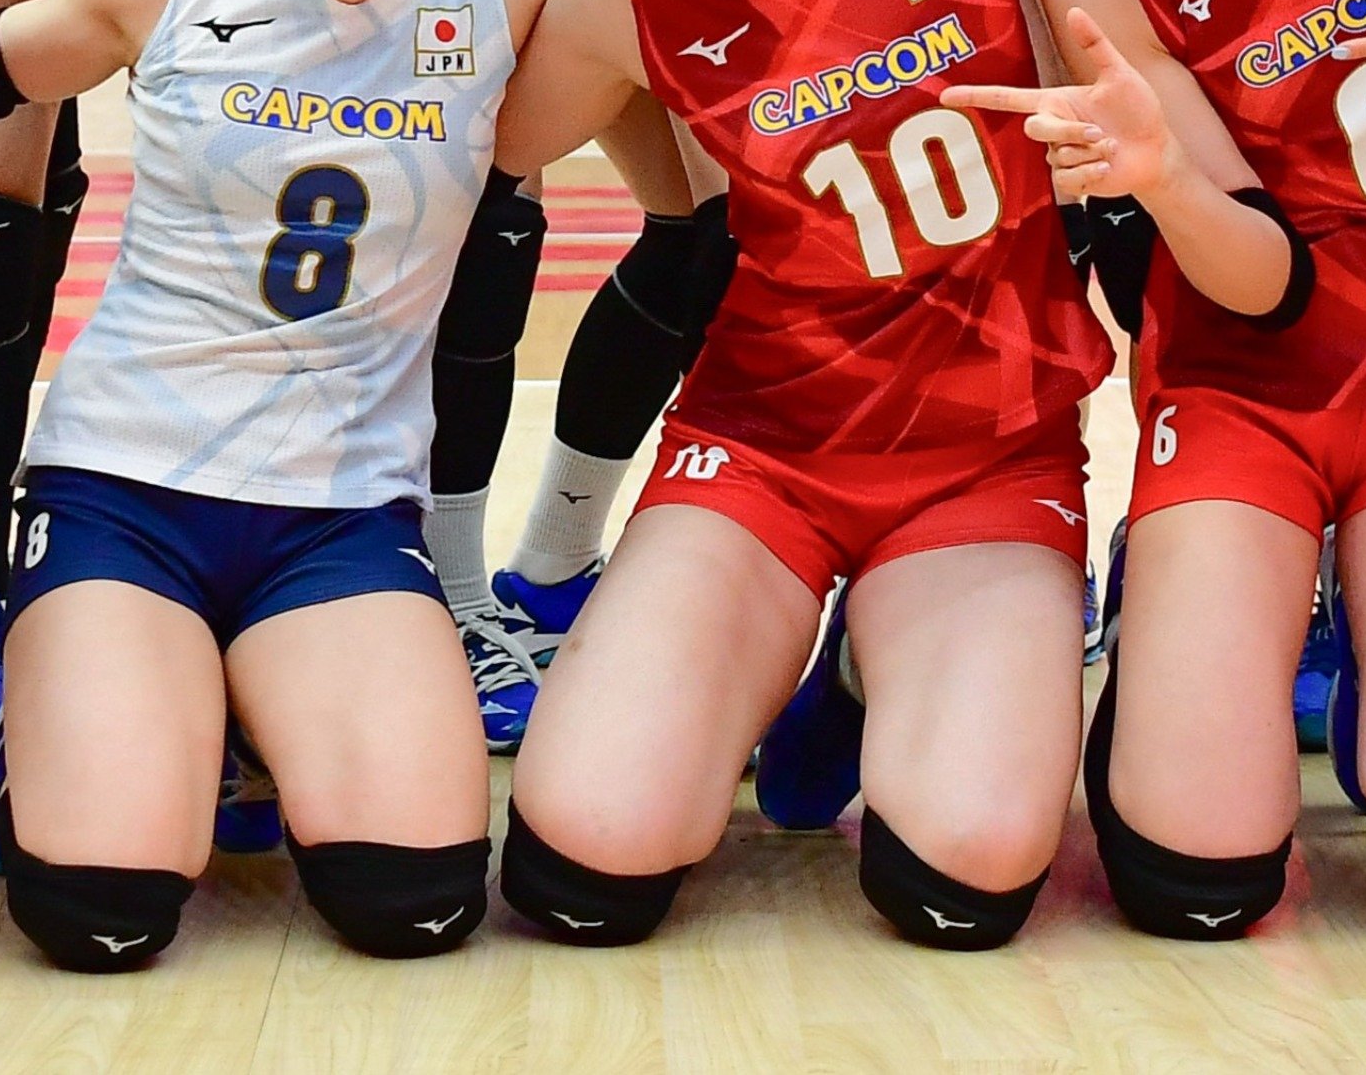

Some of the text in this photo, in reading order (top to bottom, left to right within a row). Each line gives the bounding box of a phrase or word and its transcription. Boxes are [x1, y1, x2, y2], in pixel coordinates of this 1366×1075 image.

[425, 53, 467, 74] JPN
[748, 13, 977, 135] CAPCOM
[221, 84, 447, 142] CAPCOM
[801, 107, 1002, 280] 10
[258, 163, 371, 322] 8
[1152, 404, 1178, 466] 6
[24, 511, 52, 569] 8
